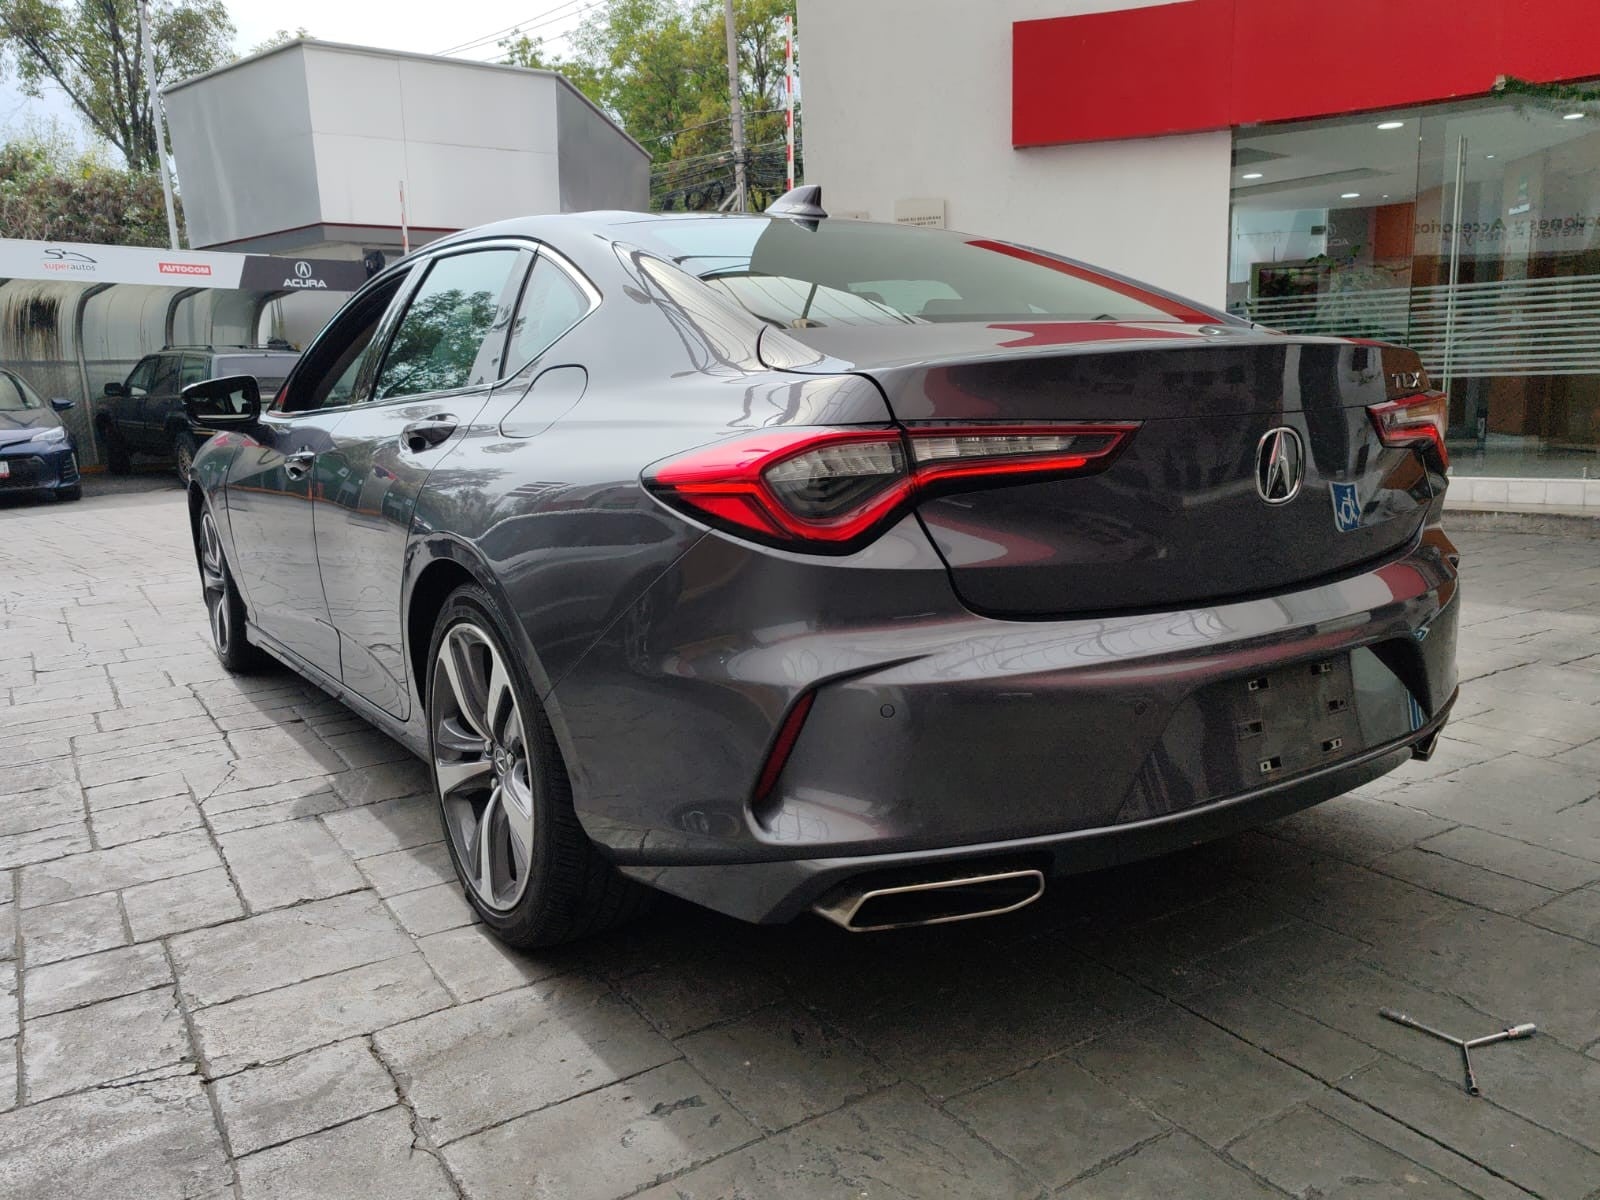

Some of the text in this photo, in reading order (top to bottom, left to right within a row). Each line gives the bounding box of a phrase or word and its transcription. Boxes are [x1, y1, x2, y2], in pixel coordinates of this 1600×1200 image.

[43, 262, 96, 272] superautos
[162, 264, 209, 274] AUTOCOM
[283, 278, 328, 288] ACURA
[1391, 371, 1420, 389] TLX
